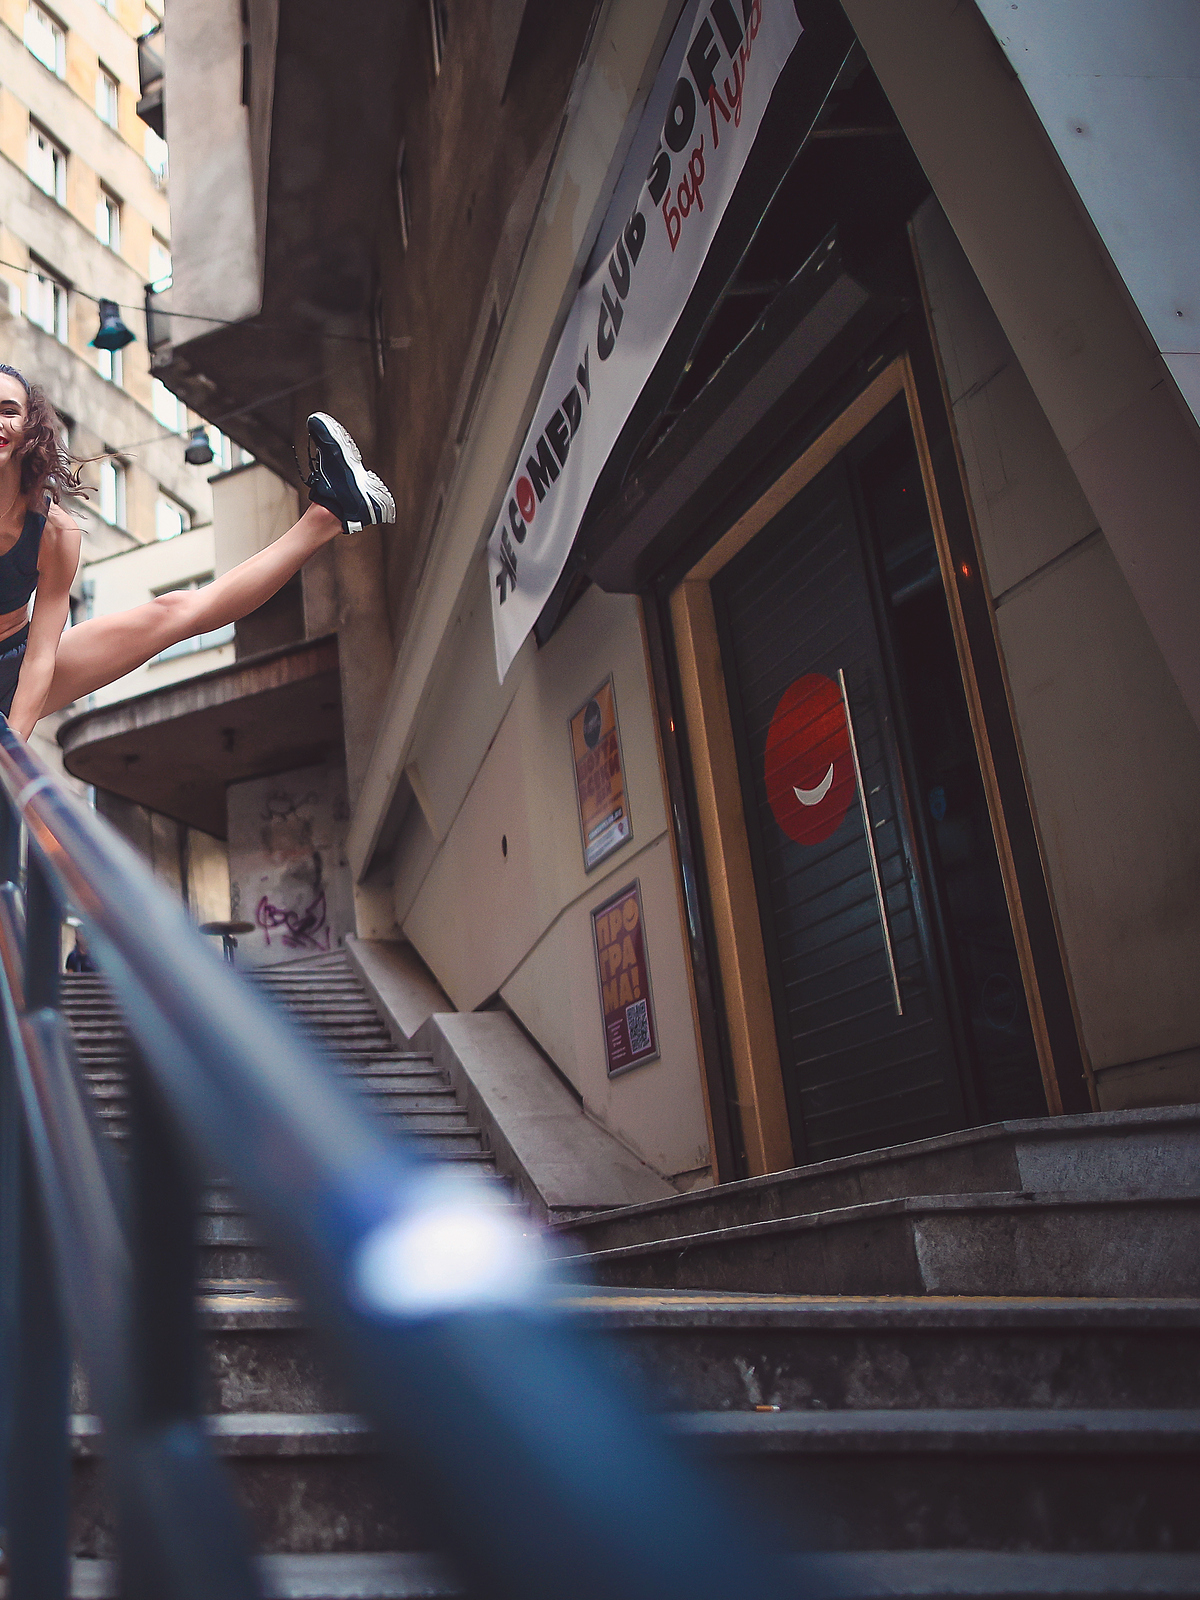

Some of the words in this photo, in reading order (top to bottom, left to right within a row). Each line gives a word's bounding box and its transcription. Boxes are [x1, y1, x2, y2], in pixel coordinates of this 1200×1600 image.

[662, 134, 705, 252] Бар
[509, 344, 590, 544] COMEDY
[647, 0, 752, 207] SOFI
[596, 899, 639, 951] ПРО
[600, 935, 638, 982] ГРА
[603, 966, 641, 1016] МА!
